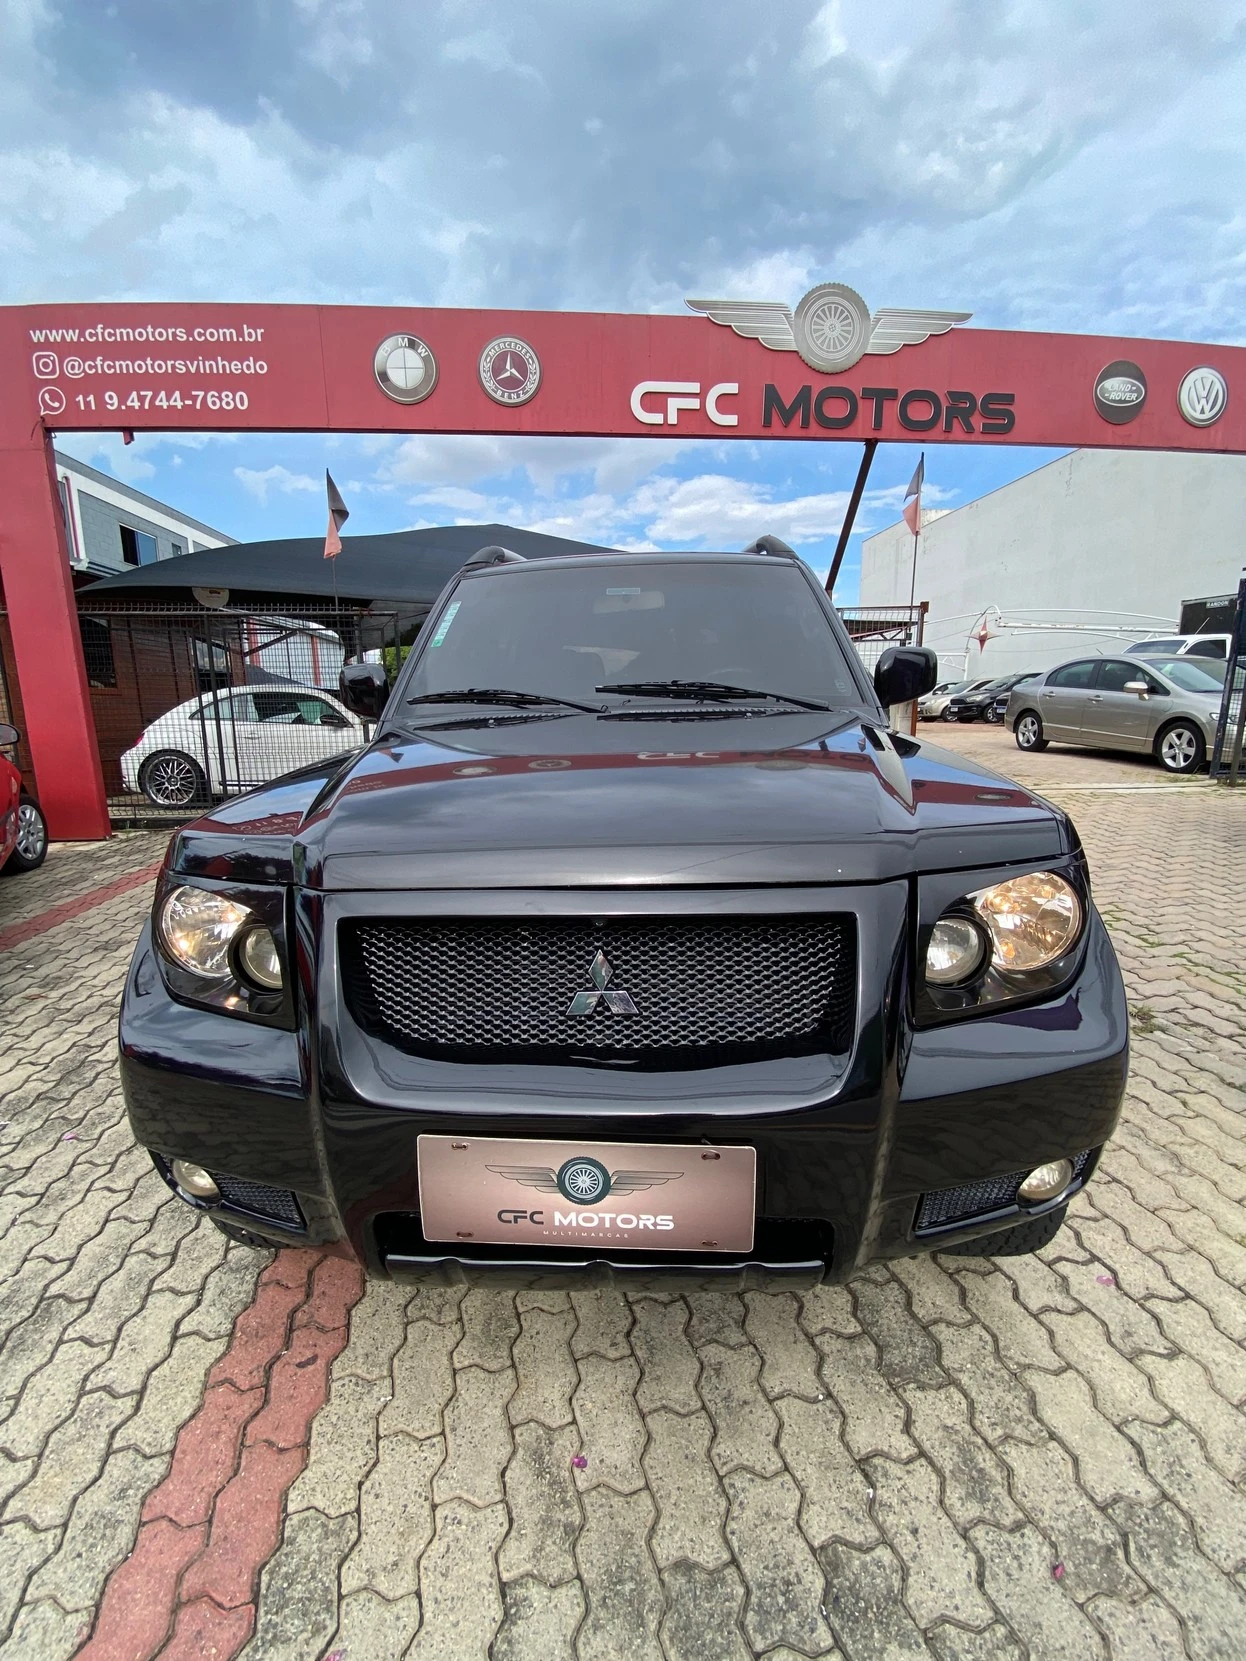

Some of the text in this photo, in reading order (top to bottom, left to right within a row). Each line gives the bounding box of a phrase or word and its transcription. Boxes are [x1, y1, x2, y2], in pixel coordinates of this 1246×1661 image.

[29, 324, 265, 343] www.cfcmotors.com.br
[380, 337, 429, 357] BMW
[488, 341, 531, 360] MERCEDES
[63, 356, 268, 379] @cfcmotorsvinhedo
[75, 390, 249, 411] 11 9.4744-7680
[497, 389, 525, 400] BENZ
[630, 381, 1016, 434] CFC MOTORS
[497, 1209, 675, 1231] CFC MOTORS
[543, 1230, 629, 1238] MULTIMARCAS
